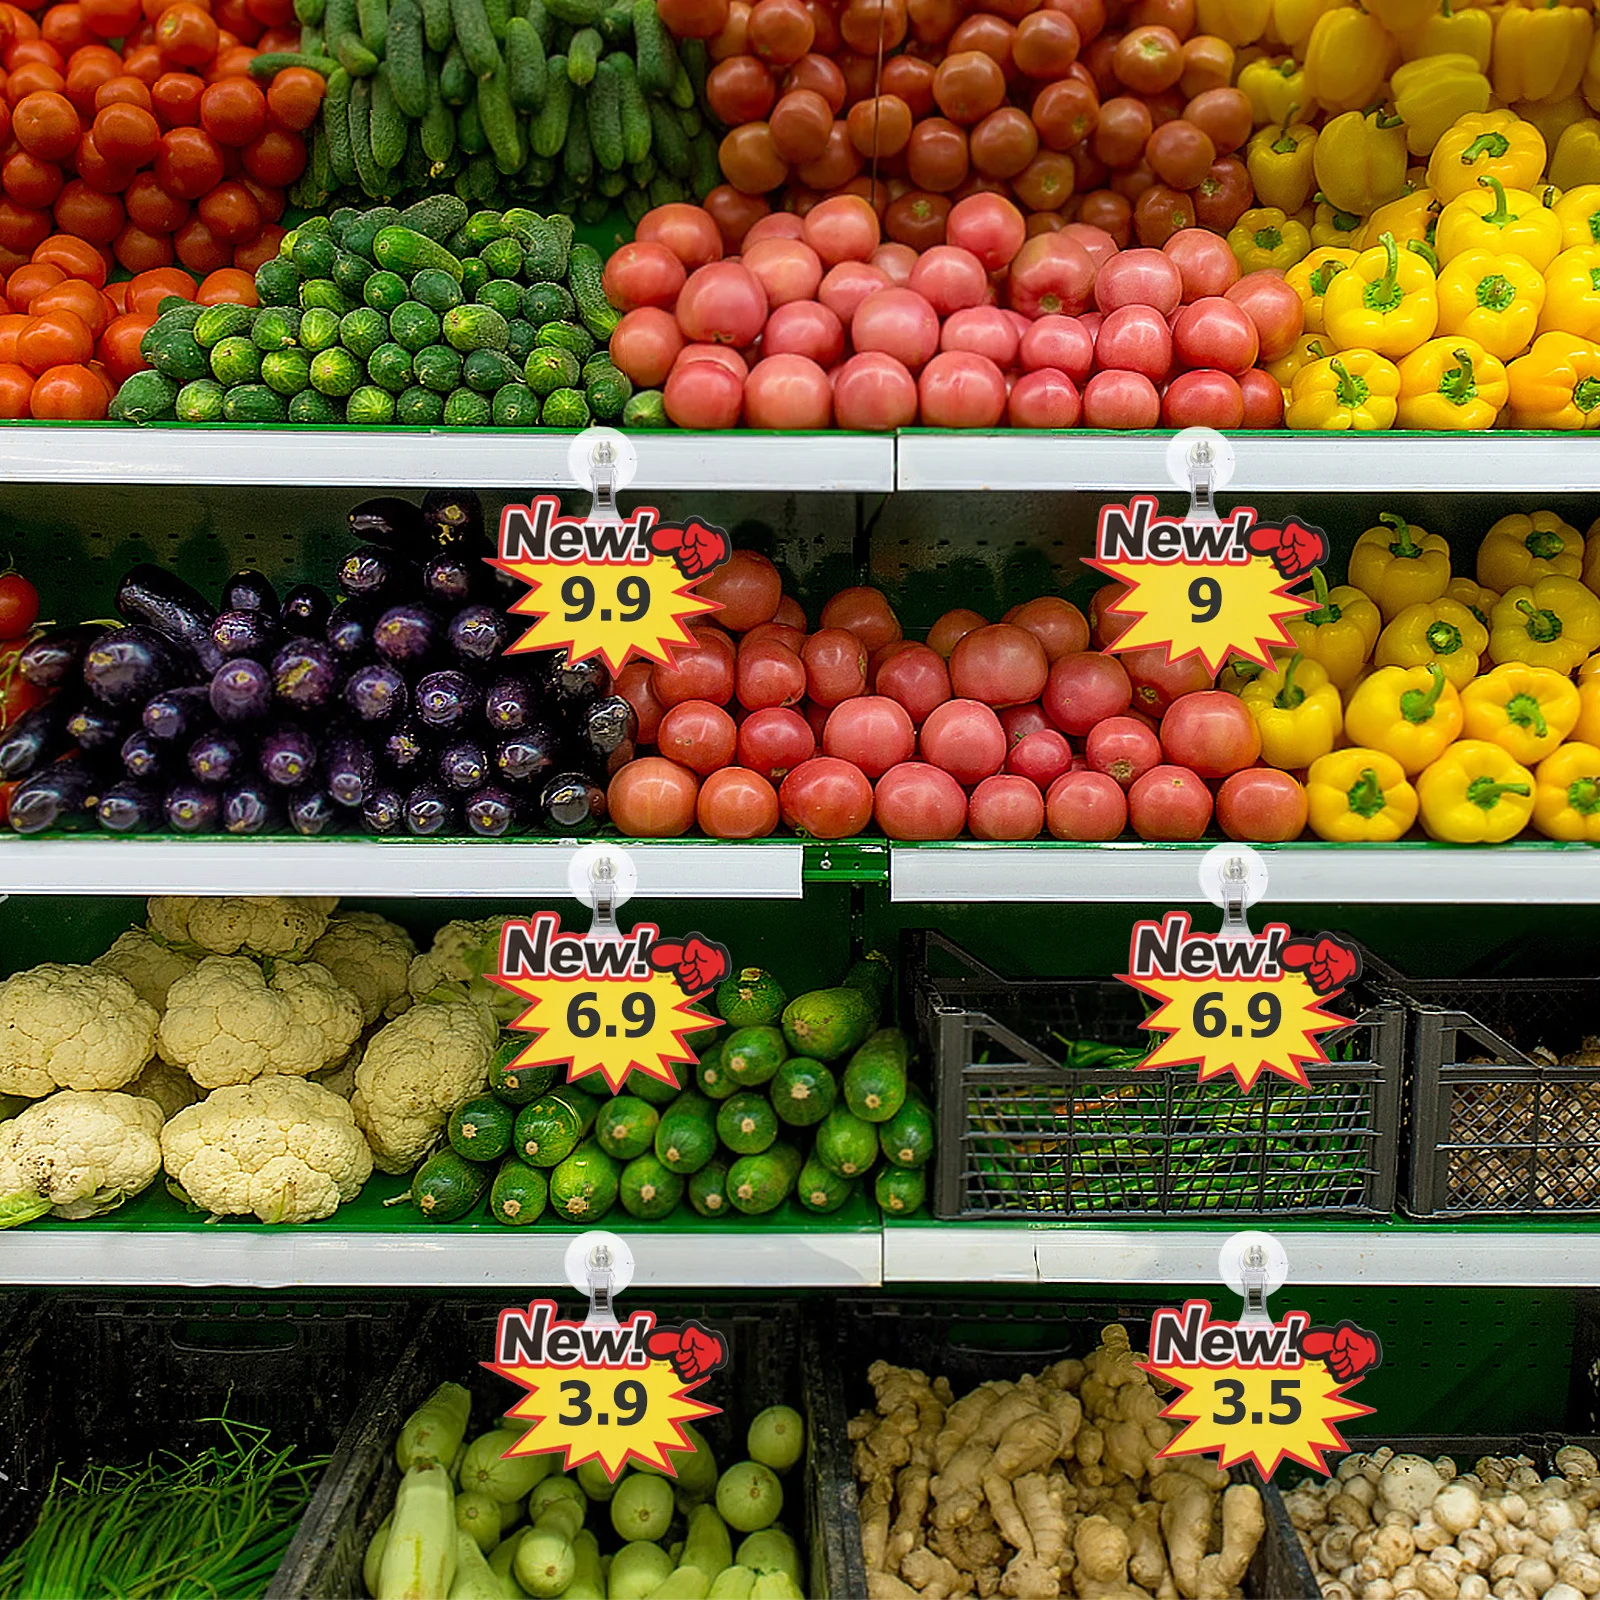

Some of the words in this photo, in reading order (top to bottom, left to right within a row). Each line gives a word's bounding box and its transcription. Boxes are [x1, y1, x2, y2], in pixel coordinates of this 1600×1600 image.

[505, 503, 653, 559] New!
[1103, 503, 1251, 559] New!
[561, 575, 651, 622] 9.9
[1188, 576, 1223, 623] 9
[505, 919, 653, 975] New!
[1136, 919, 1284, 975] New!
[566, 991, 656, 1038] 6.9
[1192, 991, 1282, 1038] 6.9
[502, 1307, 650, 1363] New!
[1156, 1307, 1304, 1363] New!
[559, 1379, 648, 1427] 3.9
[1213, 1378, 1302, 1425] 3.5
